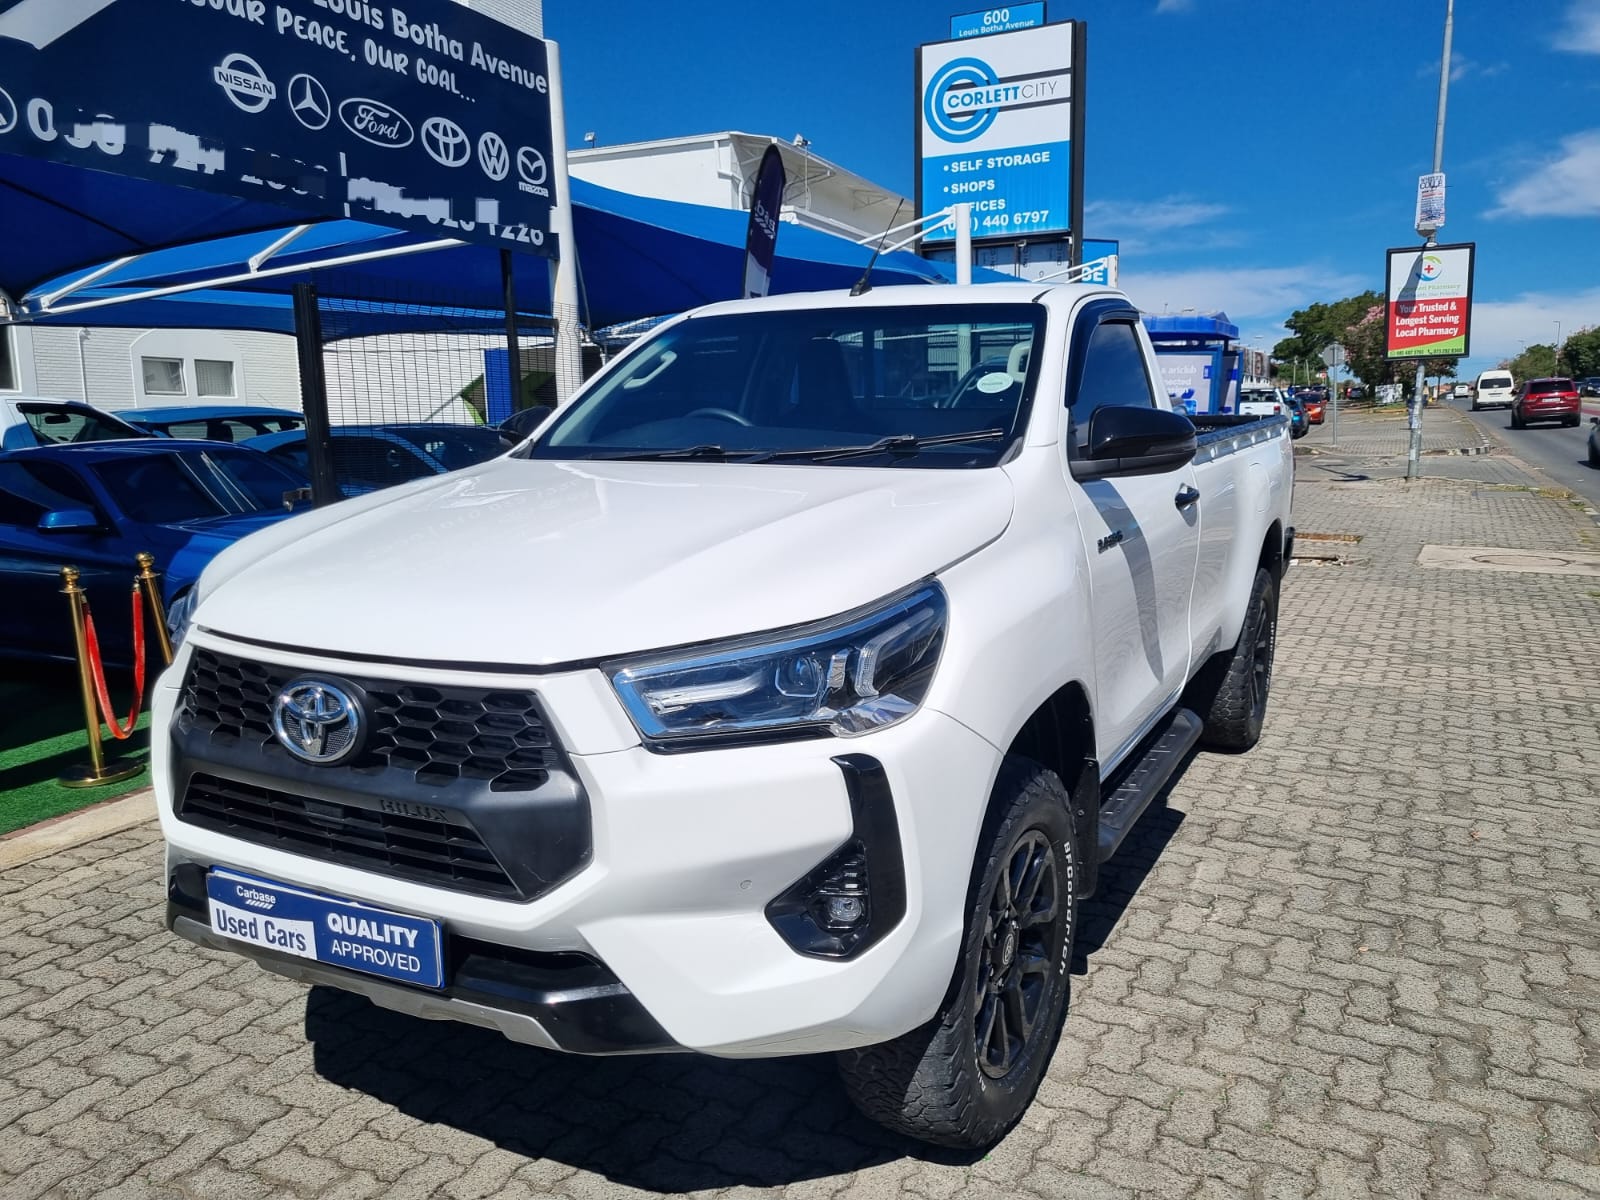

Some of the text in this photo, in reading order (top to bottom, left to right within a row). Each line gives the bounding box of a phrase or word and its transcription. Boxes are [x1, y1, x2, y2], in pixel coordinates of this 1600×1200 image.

[983, 9, 1010, 25] 600
[959, 20, 1035, 37] Louis Botha Avenue
[277, 5, 356, 62] PEACE,
[365, 38, 408, 75] OUR
[392, 8, 463, 61] Botha
[470, 42, 547, 94] Avenue
[218, 71, 273, 96] NISSAN
[353, 104, 400, 140] Ford
[951, 151, 1051, 173] SELF STORAGE
[518, 181, 549, 198] mazda
[950, 179, 995, 194] SHOPS
[982, 213, 1009, 228] 440
[1013, 210, 1049, 224] 6797
[1400, 301, 1457, 314] Your Trusted &
[1395, 314, 1460, 327] Longest Serving
[1395, 327, 1459, 338] Local Pharmacy
[379, 798, 449, 823] HILUX
[236, 884, 277, 904] Carbase
[215, 906, 307, 952] Used Cars
[326, 912, 419, 949] QUALITY
[331, 938, 421, 973] APPROVED
